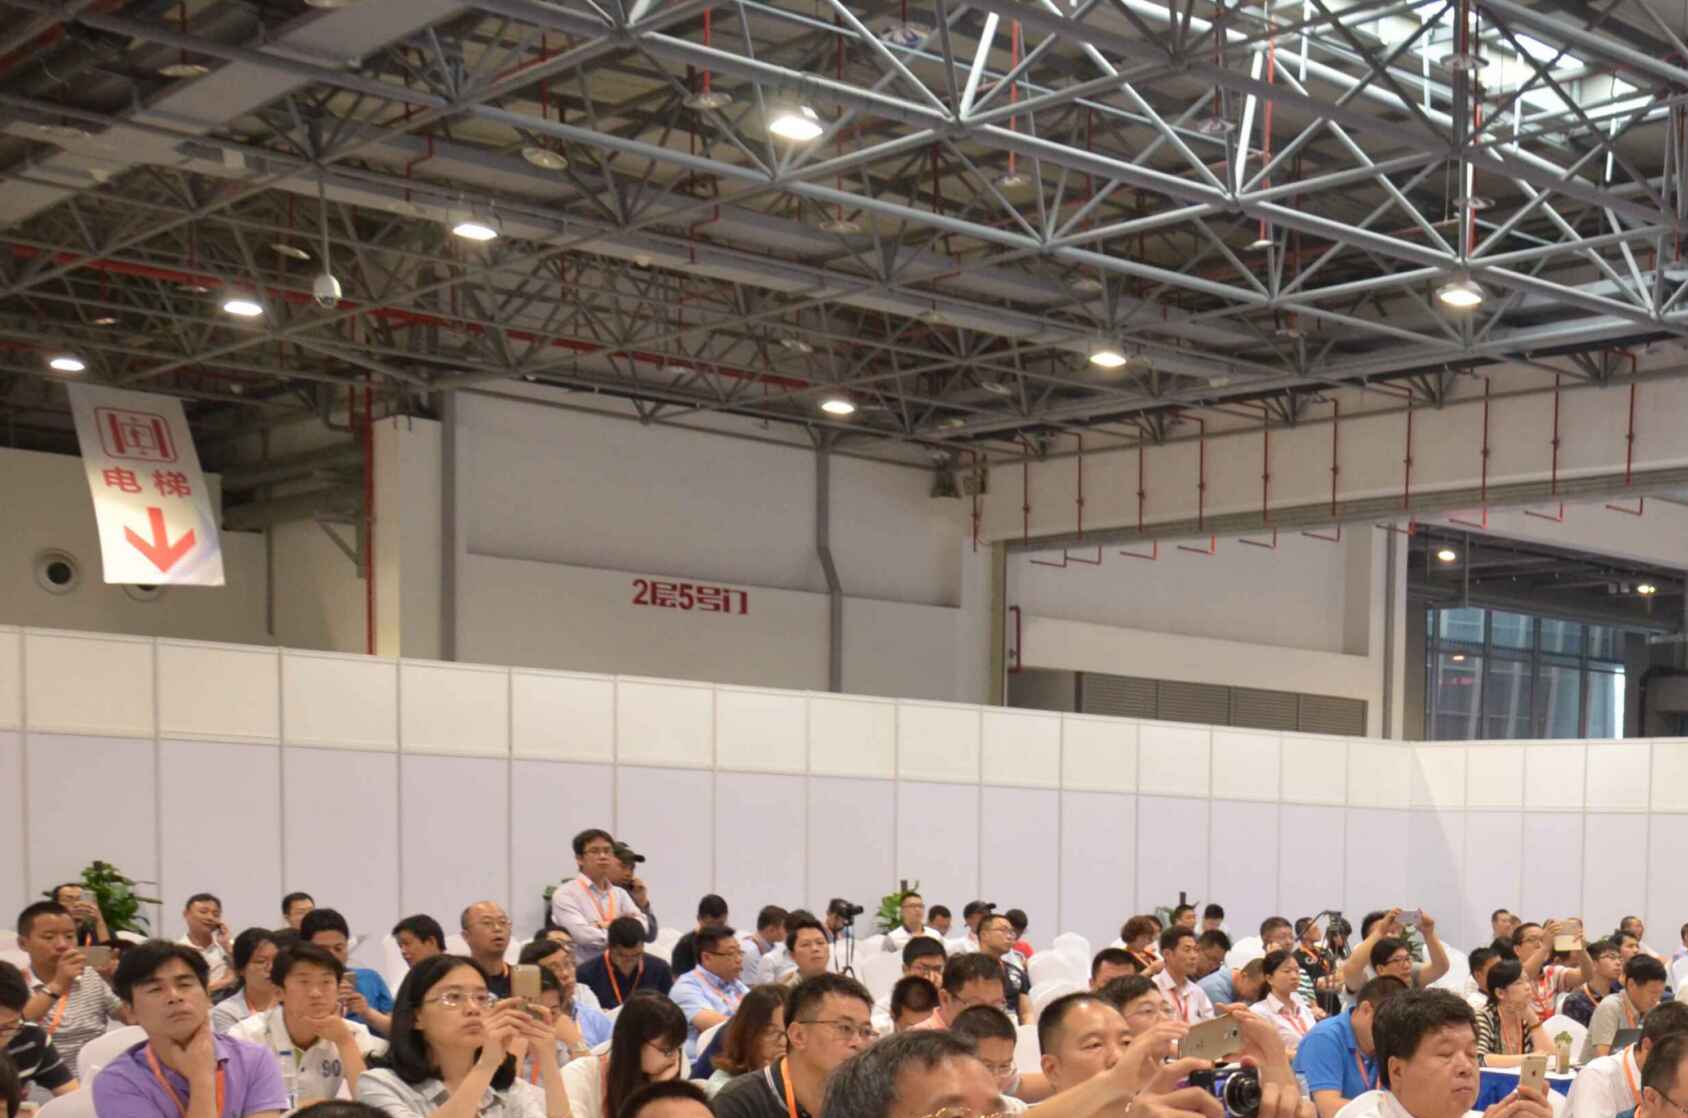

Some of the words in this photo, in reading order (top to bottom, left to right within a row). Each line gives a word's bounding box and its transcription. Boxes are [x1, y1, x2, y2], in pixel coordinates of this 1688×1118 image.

[102, 466, 192, 498] 电梯
[632, 579, 748, 615] 2层5号门
